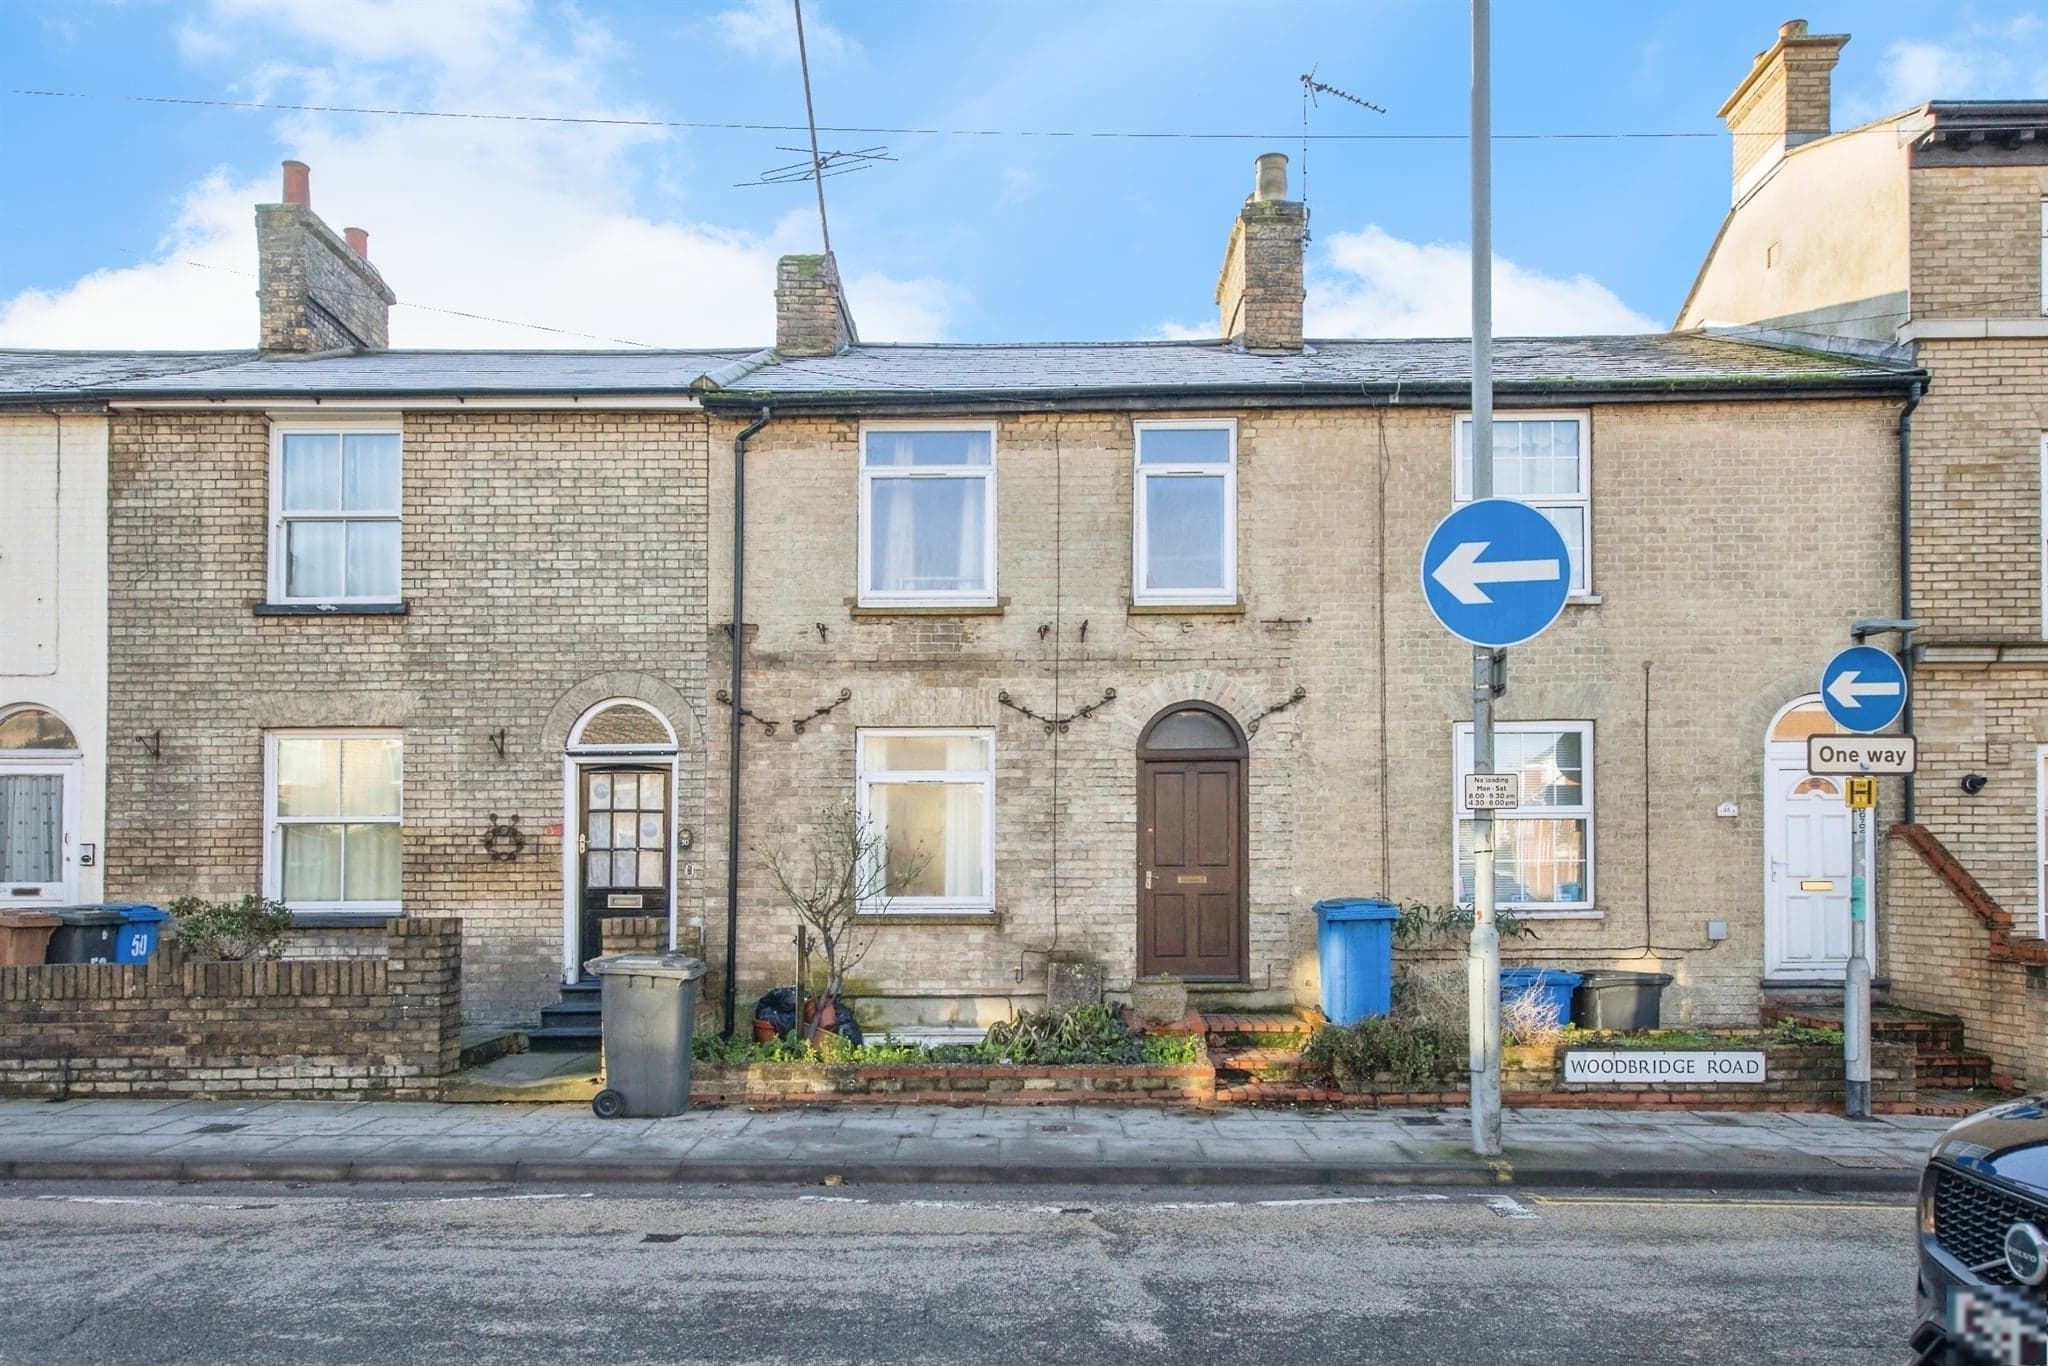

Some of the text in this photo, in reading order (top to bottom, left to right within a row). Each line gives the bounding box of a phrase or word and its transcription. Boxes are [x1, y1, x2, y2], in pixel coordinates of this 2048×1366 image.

[1819, 745, 1907, 766] One way
[131, 934, 148, 957] 50
[1571, 1058, 1760, 1074] WOODBRIDGE ROAD
